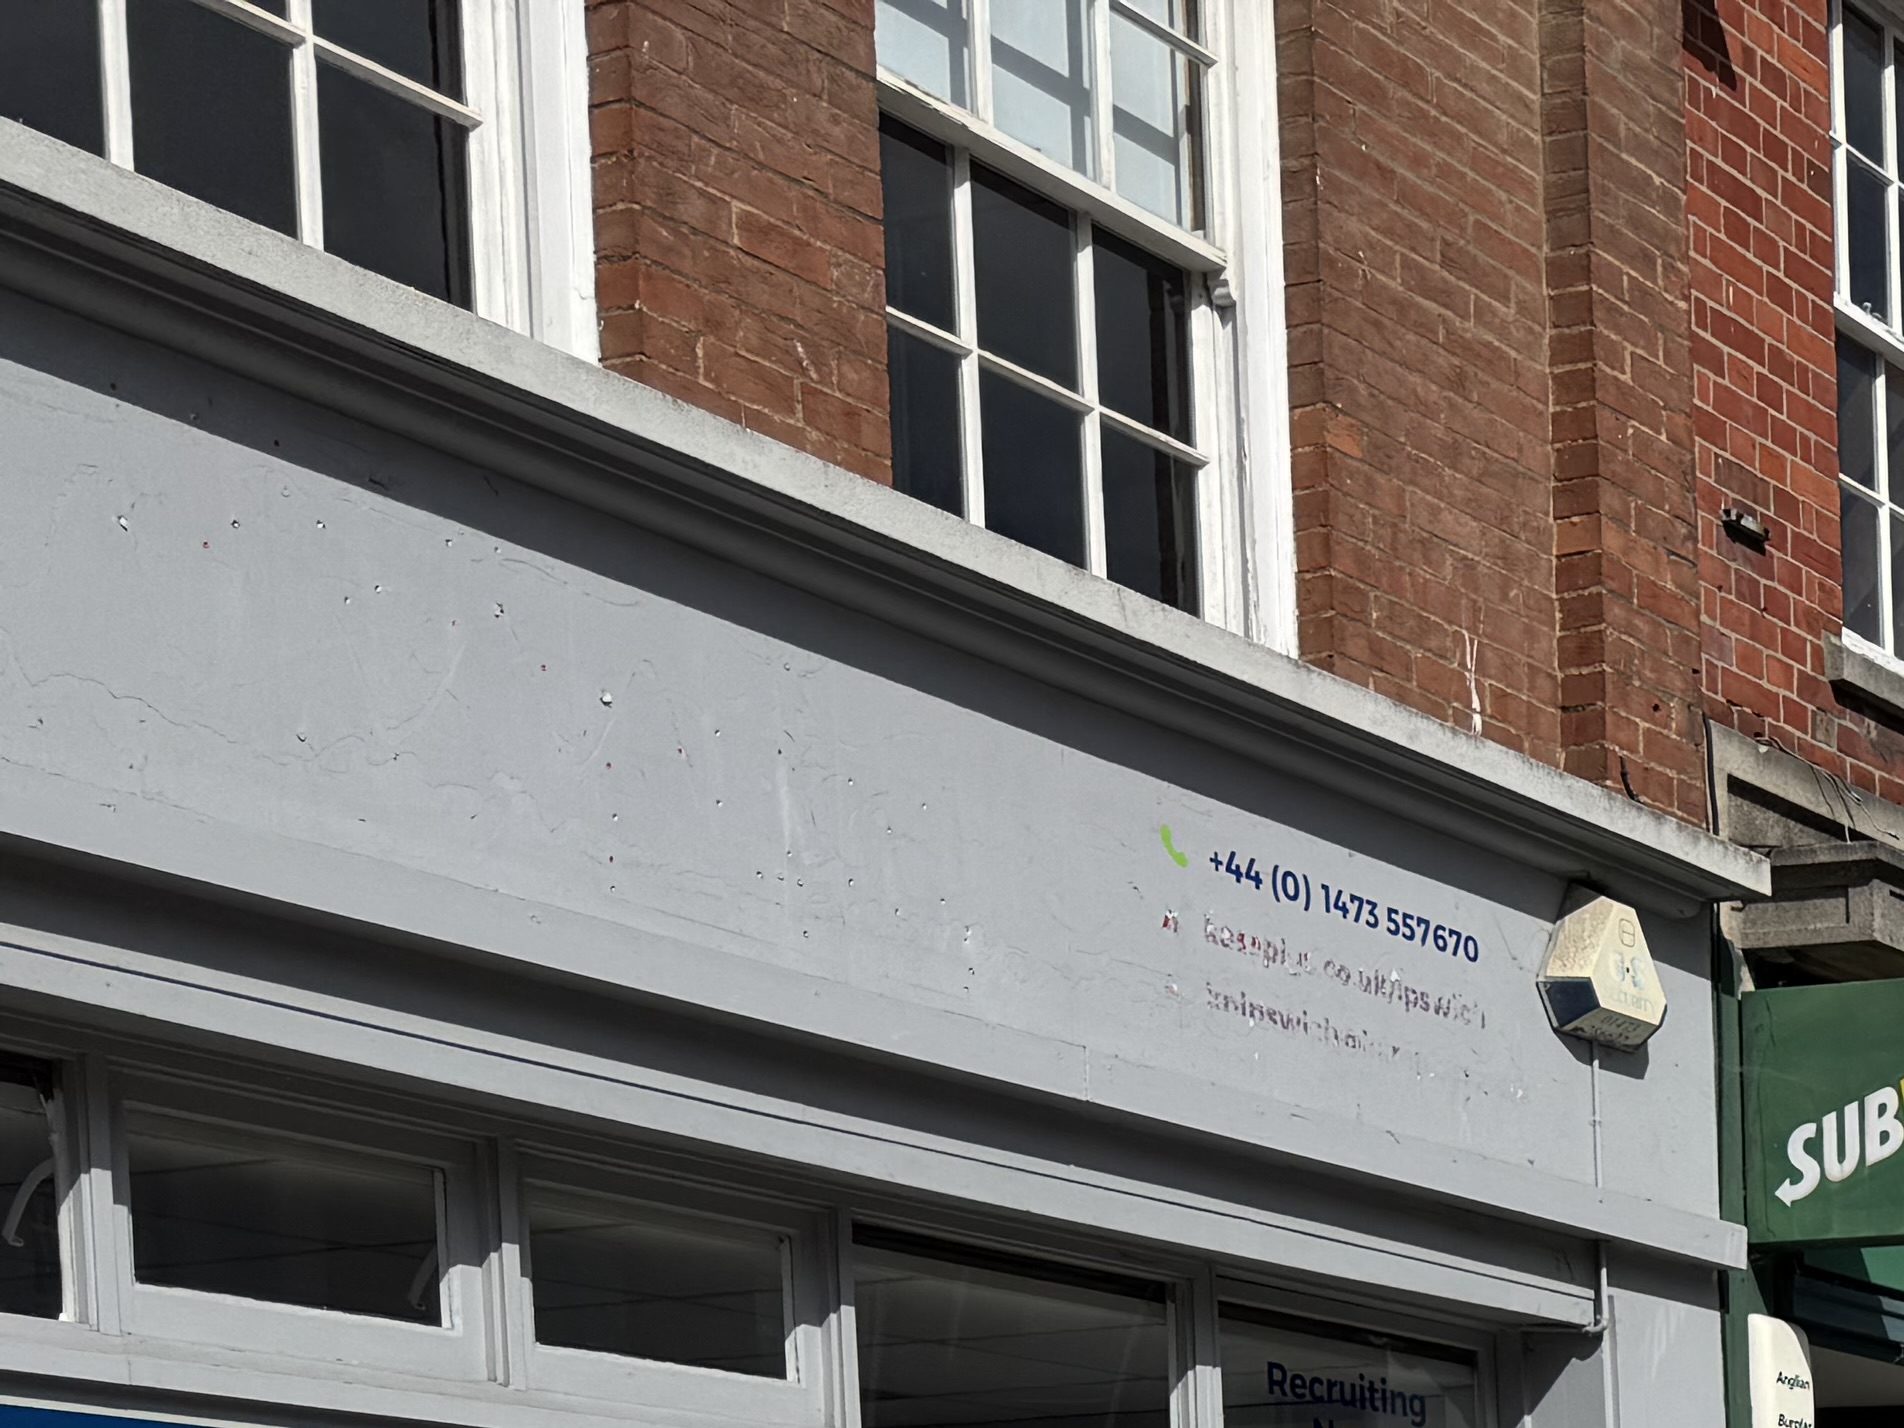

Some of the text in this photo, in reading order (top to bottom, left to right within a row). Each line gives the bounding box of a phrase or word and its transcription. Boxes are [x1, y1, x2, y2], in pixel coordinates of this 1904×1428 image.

[1209, 851, 1479, 963] +44 (0) 1473 557670
[1266, 1361, 1427, 1428] Recruiting
[1776, 1371, 1810, 1389] Anglian
